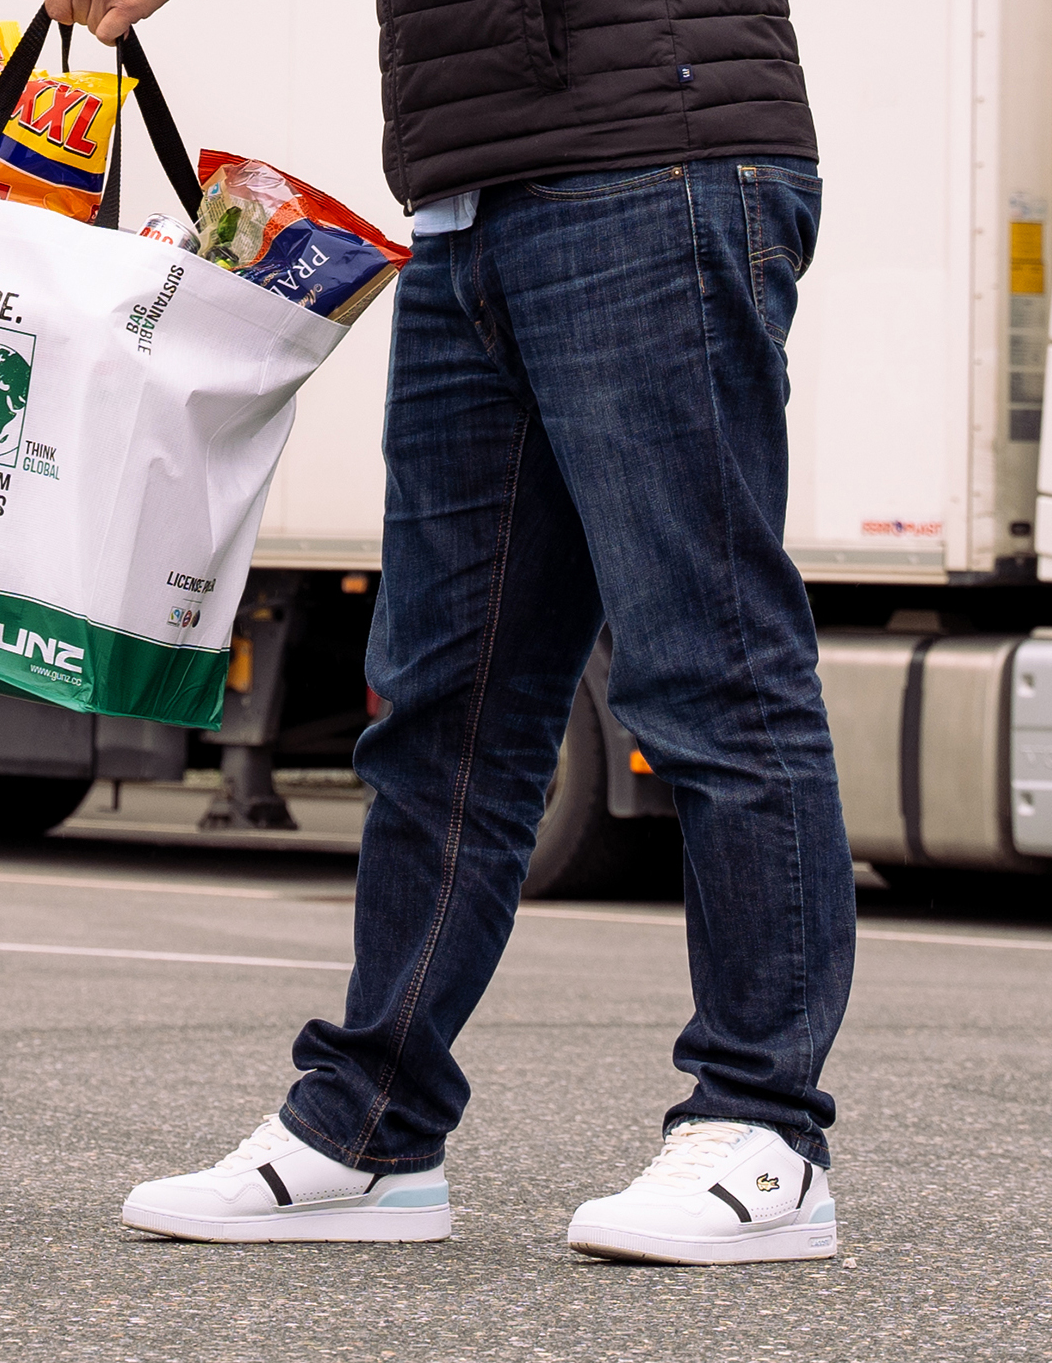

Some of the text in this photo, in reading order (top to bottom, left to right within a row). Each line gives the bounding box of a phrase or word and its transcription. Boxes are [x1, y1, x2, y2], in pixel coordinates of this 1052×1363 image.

[126, 304, 148, 334] BAG
[137, 264, 185, 356] SUSTAINABLE
[24, 440, 57, 462] THINK
[22, 457, 60, 480] GLOBAL
[166, 570, 205, 593] LICENSE
[30, 663, 82, 687] www.gunz.cc
